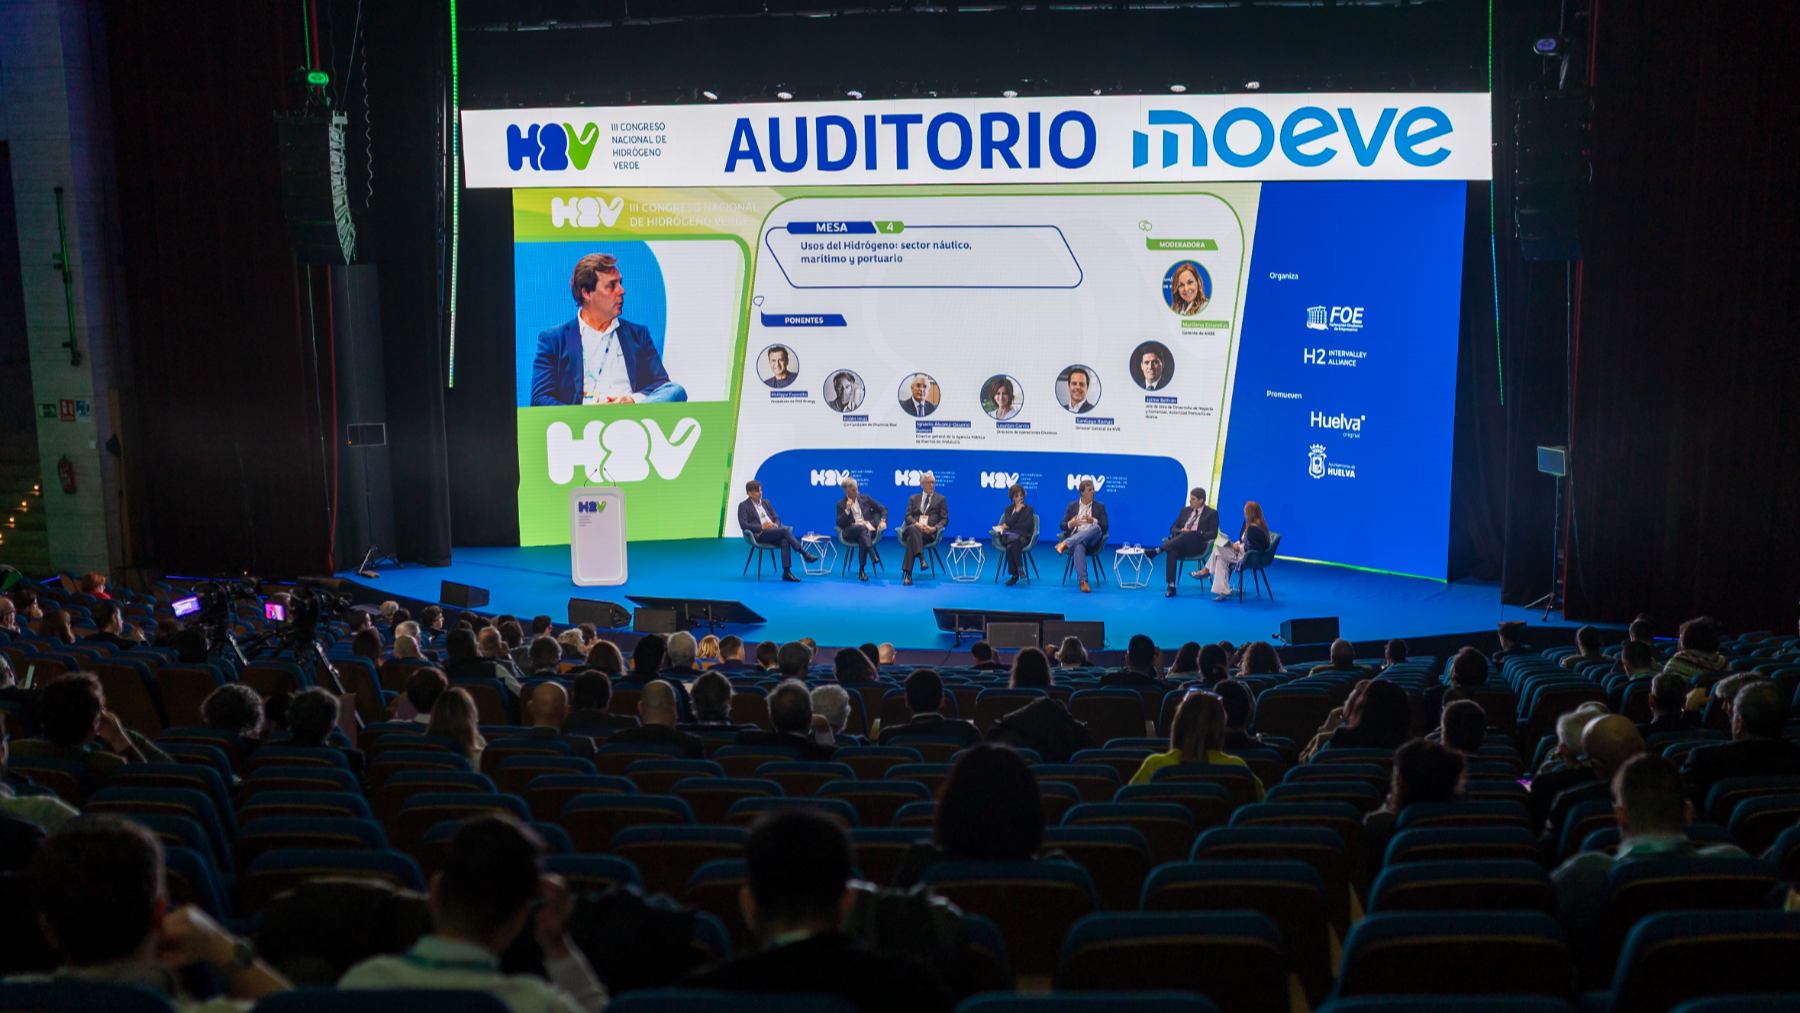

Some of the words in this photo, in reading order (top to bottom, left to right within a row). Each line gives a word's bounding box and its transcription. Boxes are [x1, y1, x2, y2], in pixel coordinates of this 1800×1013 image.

[620, 122, 666, 131] CONGRESO
[612, 136, 653, 144] NACIONAL
[656, 136, 667, 144] DE
[724, 110, 1097, 172] AUDITORIO
[1133, 106, 1454, 169] moeve
[612, 147, 662, 157] HIDRÓGENO
[613, 161, 640, 170] VERDE
[629, 203, 639, 213] III
[630, 217, 644, 227] DE
[816, 222, 848, 232] MESA
[886, 223, 894, 232] 4
[800, 241, 824, 250] Usos
[826, 240, 842, 250] del
[844, 240, 898, 252] Hidrógeno:
[900, 240, 930, 250] sector
[932, 240, 972, 250] náutico,
[1159, 241, 1206, 249] MODERADORA
[800, 254, 846, 264] marítimo
[849, 255, 855, 266] y
[858, 254, 903, 264] portuario
[1270, 272, 1299, 281] Organiza
[1330, 306, 1364, 324] FOE
[1304, 348, 1326, 365] H2
[1328, 350, 1367, 358] INTERVALLEY
[1266, 390, 1302, 399] Promueven
[1310, 411, 1360, 431] Huelva
[1328, 468, 1356, 478] HUELVA
